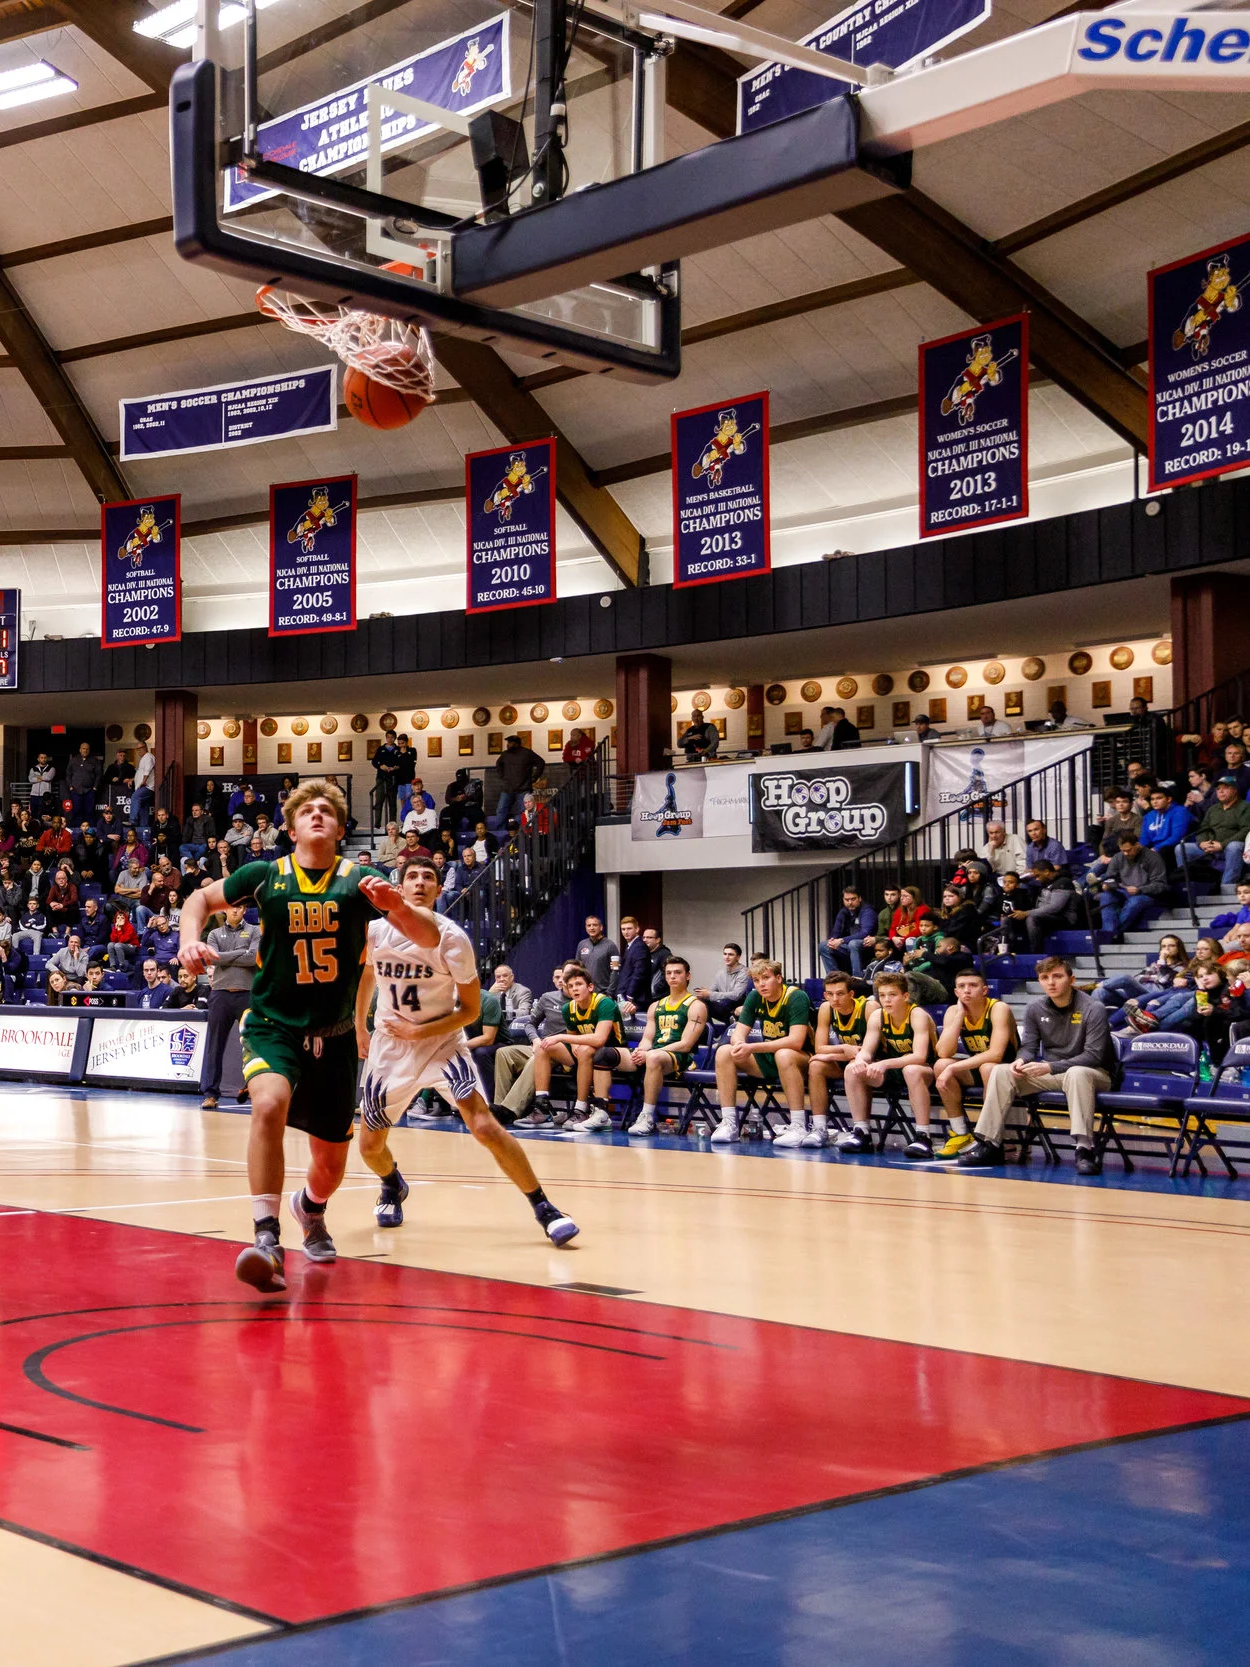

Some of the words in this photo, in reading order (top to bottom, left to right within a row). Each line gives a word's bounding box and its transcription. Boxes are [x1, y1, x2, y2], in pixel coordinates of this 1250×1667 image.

[751, 63, 782, 93] MEN'S
[819, 6, 872, 49] COUNTRY
[1077, 17, 1250, 64] Sche
[300, 92, 359, 131] JERSEY
[318, 104, 395, 147] ATHLEIC
[299, 114, 417, 172] CHAMPIONHIPS
[1167, 362, 1209, 383] WOMEN'S
[1210, 350, 1247, 370] SOCCER
[147, 401, 178, 413] MEN'S
[180, 395, 218, 408] SOCCER
[221, 379, 305, 402] CHAMPIONSHIPS
[1156, 387, 1186, 404] NJCAA
[1184, 381, 1201, 396] DIV.
[1203, 377, 1213, 389] III
[1156, 379, 1250, 423] CHAMPION
[937, 427, 975, 443] WOMEN'S
[976, 418, 1008, 434] SOCCER
[1180, 411, 1234, 448] 2014
[928, 448, 951, 461] NJCAA
[952, 444, 968, 456] DIV.
[969, 440, 978, 451] III
[980, 430, 1018, 448] NATIONAL
[928, 443, 1019, 478] CHAMPIONS
[1164, 448, 1222, 474] RECORD:
[686, 493, 708, 504] MEN'S
[709, 484, 754, 500] BASKETBALL
[949, 471, 997, 500] 2013
[680, 508, 702, 519] NJCAA
[703, 505, 716, 516] DIV.
[718, 502, 726, 511] III
[727, 495, 761, 510] NATIONAL
[930, 503, 981, 524] RECORD:
[984, 495, 1018, 512] 17-1-1
[494, 524, 527, 535] SOFTBALL
[681, 507, 762, 534] CHAMPIONS
[473, 541, 493, 550] NJCAA
[494, 538, 507, 547] DIV.
[517, 532, 548, 544] NATIONAL
[473, 543, 549, 564] CHAMPIONS
[700, 531, 742, 555] 2013
[276, 568, 295, 577] NJCAA
[319, 563, 349, 572] NATIONAL
[296, 554, 329, 563] SOFTBALL
[687, 558, 734, 575] RECORD:
[736, 554, 756, 566] 33-1
[108, 583, 125, 591] NJCAA
[127, 581, 138, 589] DIV.
[146, 577, 173, 587] NATIONAL
[126, 569, 155, 578] SOFTBALL
[276, 573, 349, 590] CHAMPIONS
[491, 564, 530, 584] 2010
[108, 586, 174, 604] CHAMPIONS
[293, 591, 332, 609] 2005
[477, 588, 520, 602] RECORD:
[521, 585, 545, 596] 45-10
[123, 605, 159, 622] 2002
[278, 614, 319, 626] RECORD:
[321, 612, 347, 622] 49-8-1
[113, 626, 150, 638] RECORD:
[152, 624, 169, 633] 47-9
[762, 776, 849, 809] Hoop
[640, 811, 664, 822] Hoop
[664, 810, 691, 819] Group
[784, 804, 886, 838] Group
[288, 900, 340, 933] RBC
[293, 938, 339, 985] 15
[376, 961, 434, 980] EAGLES
[389, 984, 421, 1012] 14
[1, 1028, 74, 1047] BROOKDALE
[91, 1044, 127, 1070] JERSEY
